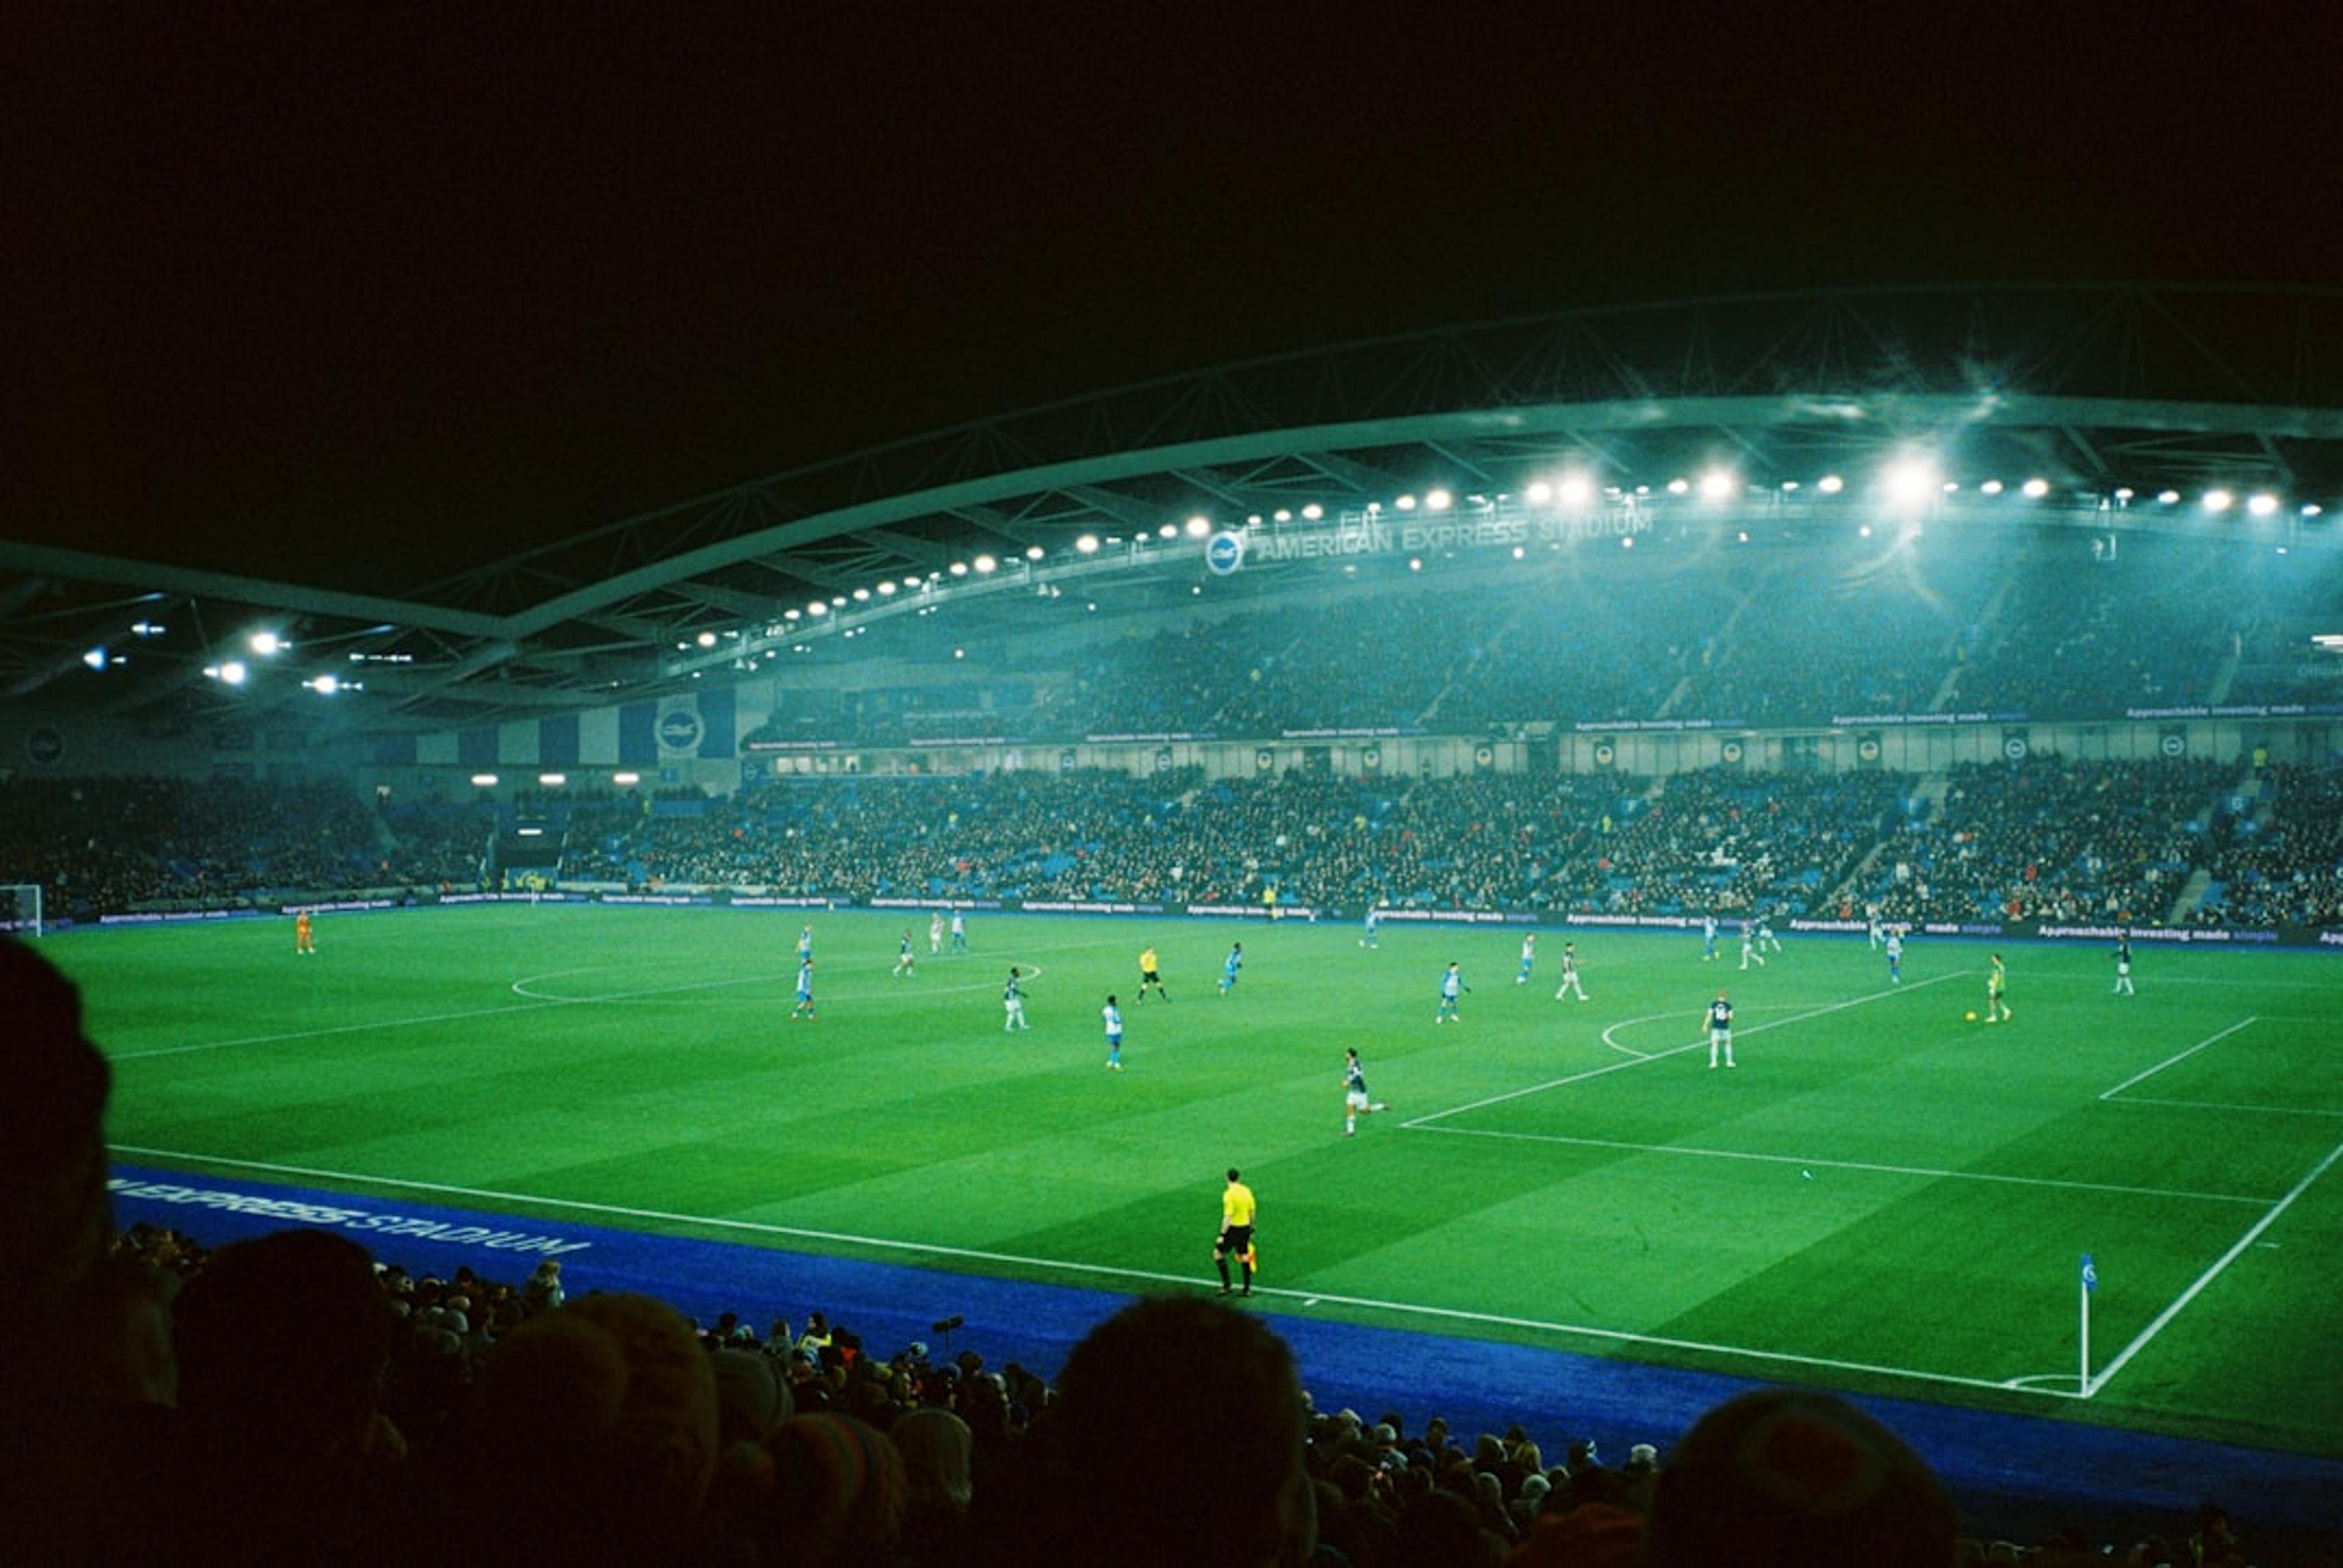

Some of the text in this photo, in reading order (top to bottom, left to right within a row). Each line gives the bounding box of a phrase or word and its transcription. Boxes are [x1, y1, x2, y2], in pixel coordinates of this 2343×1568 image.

[1257, 511, 1652, 560] AMERICAN EXPRESS STADIUM
[2129, 926, 2190, 941] investing
[2193, 929, 2230, 940] made
[345, 1216, 591, 1255] STADIUM
